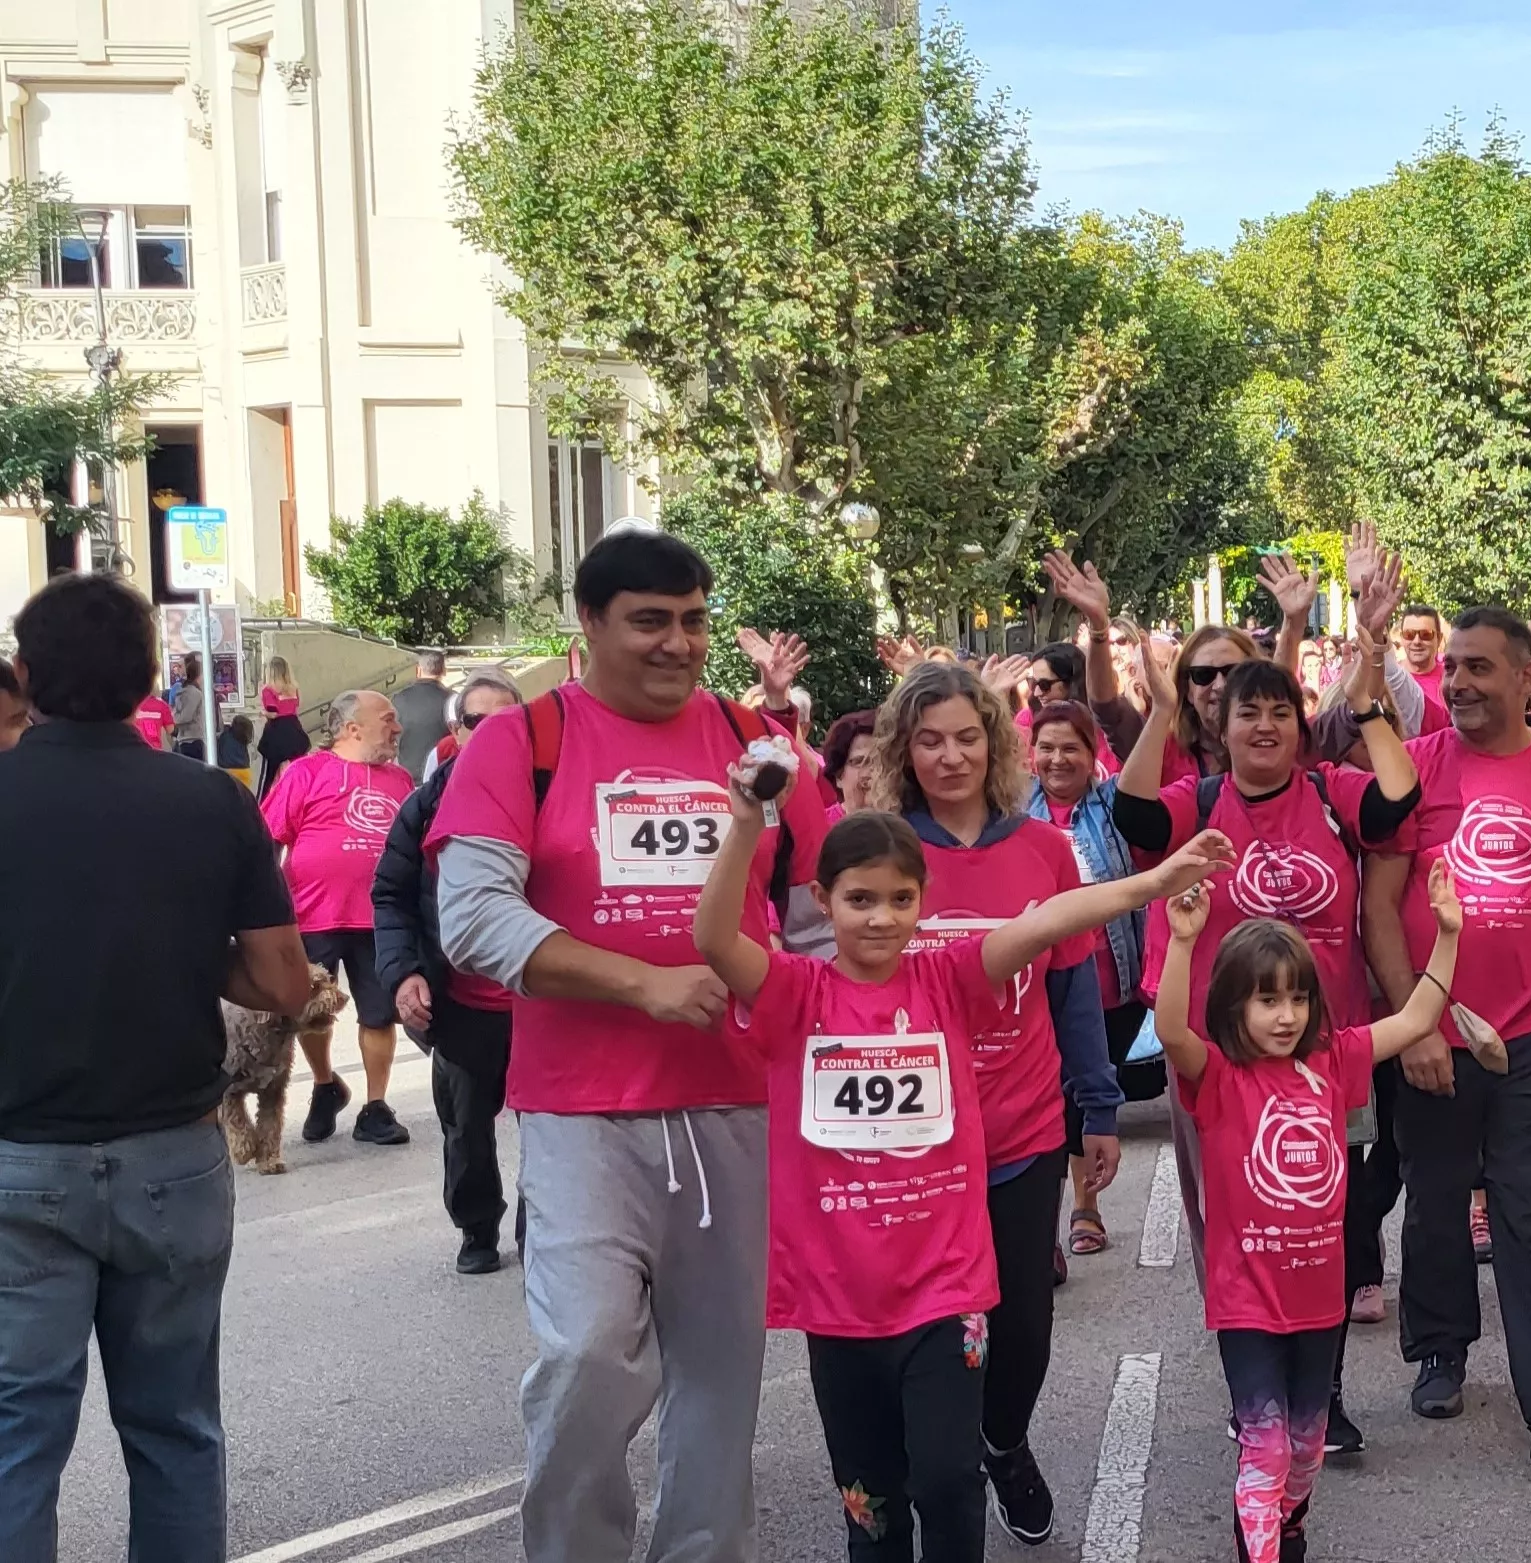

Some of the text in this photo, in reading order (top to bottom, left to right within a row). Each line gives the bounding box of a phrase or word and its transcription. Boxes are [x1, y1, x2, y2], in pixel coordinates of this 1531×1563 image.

[656, 795, 691, 804] HUESCA
[616, 801, 729, 814] CONTRA EL CÁNCER
[630, 817, 720, 856] 493
[937, 930, 969, 938] HUESCA
[905, 939, 946, 949] ONTRA
[861, 1049, 898, 1058] HUESCA
[821, 1055, 935, 1070] CONTRA EL CÁNCER
[834, 1074, 925, 1116] 492
